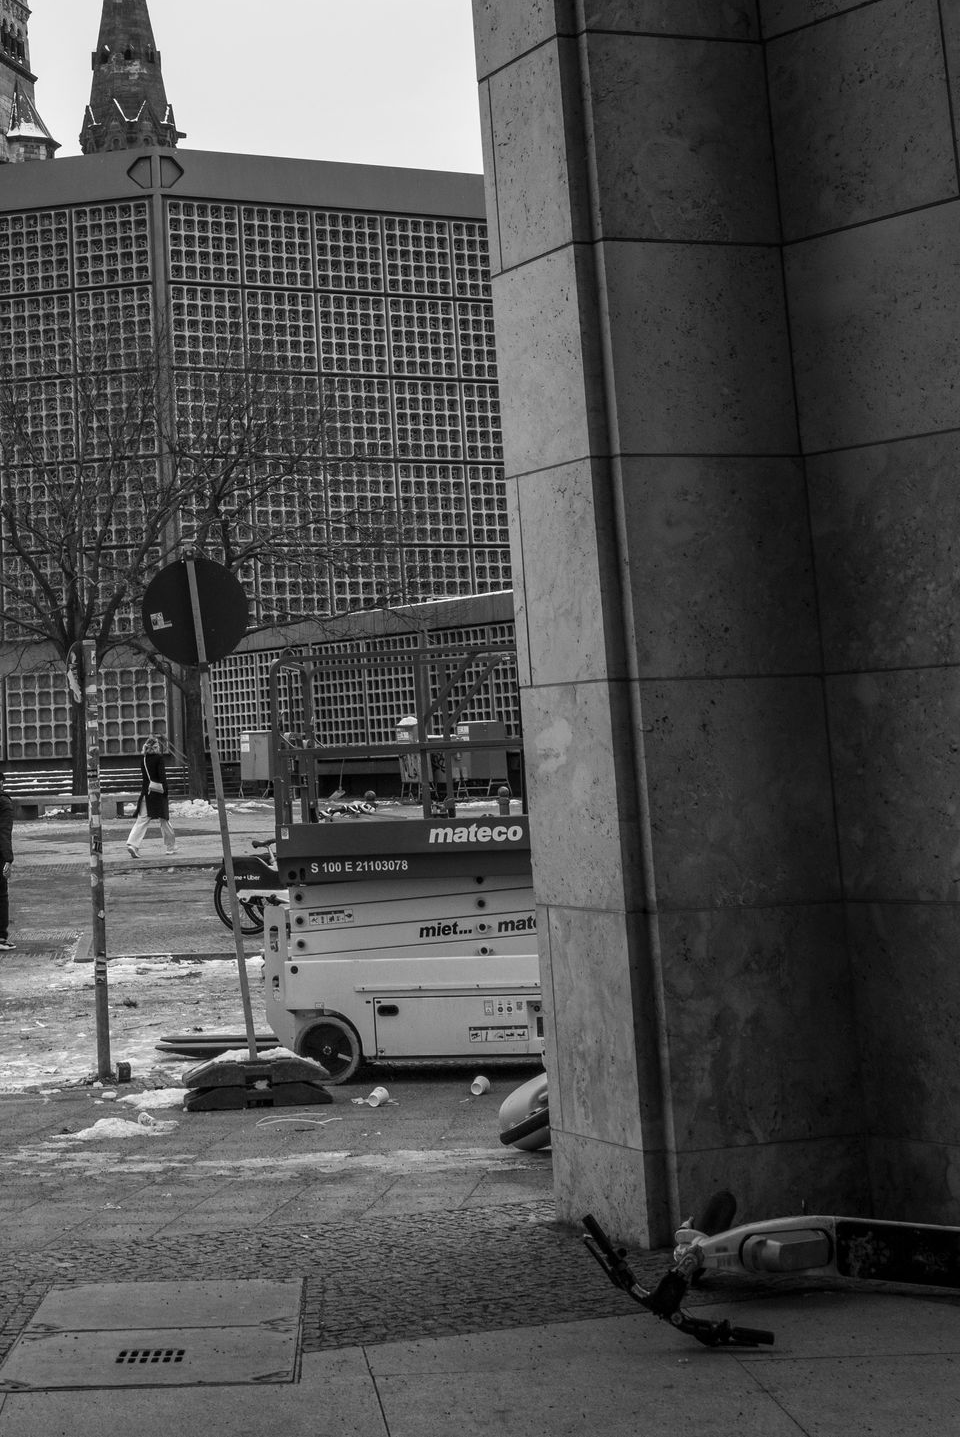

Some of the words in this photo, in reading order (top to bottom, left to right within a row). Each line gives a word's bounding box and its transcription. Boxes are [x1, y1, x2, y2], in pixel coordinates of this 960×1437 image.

[428, 823, 523, 844] mateco
[311, 862, 319, 873] S
[322, 862, 341, 872] 100
[345, 861, 353, 872] E
[356, 860, 409, 872] 21103078
[419, 921, 473, 938] miet...
